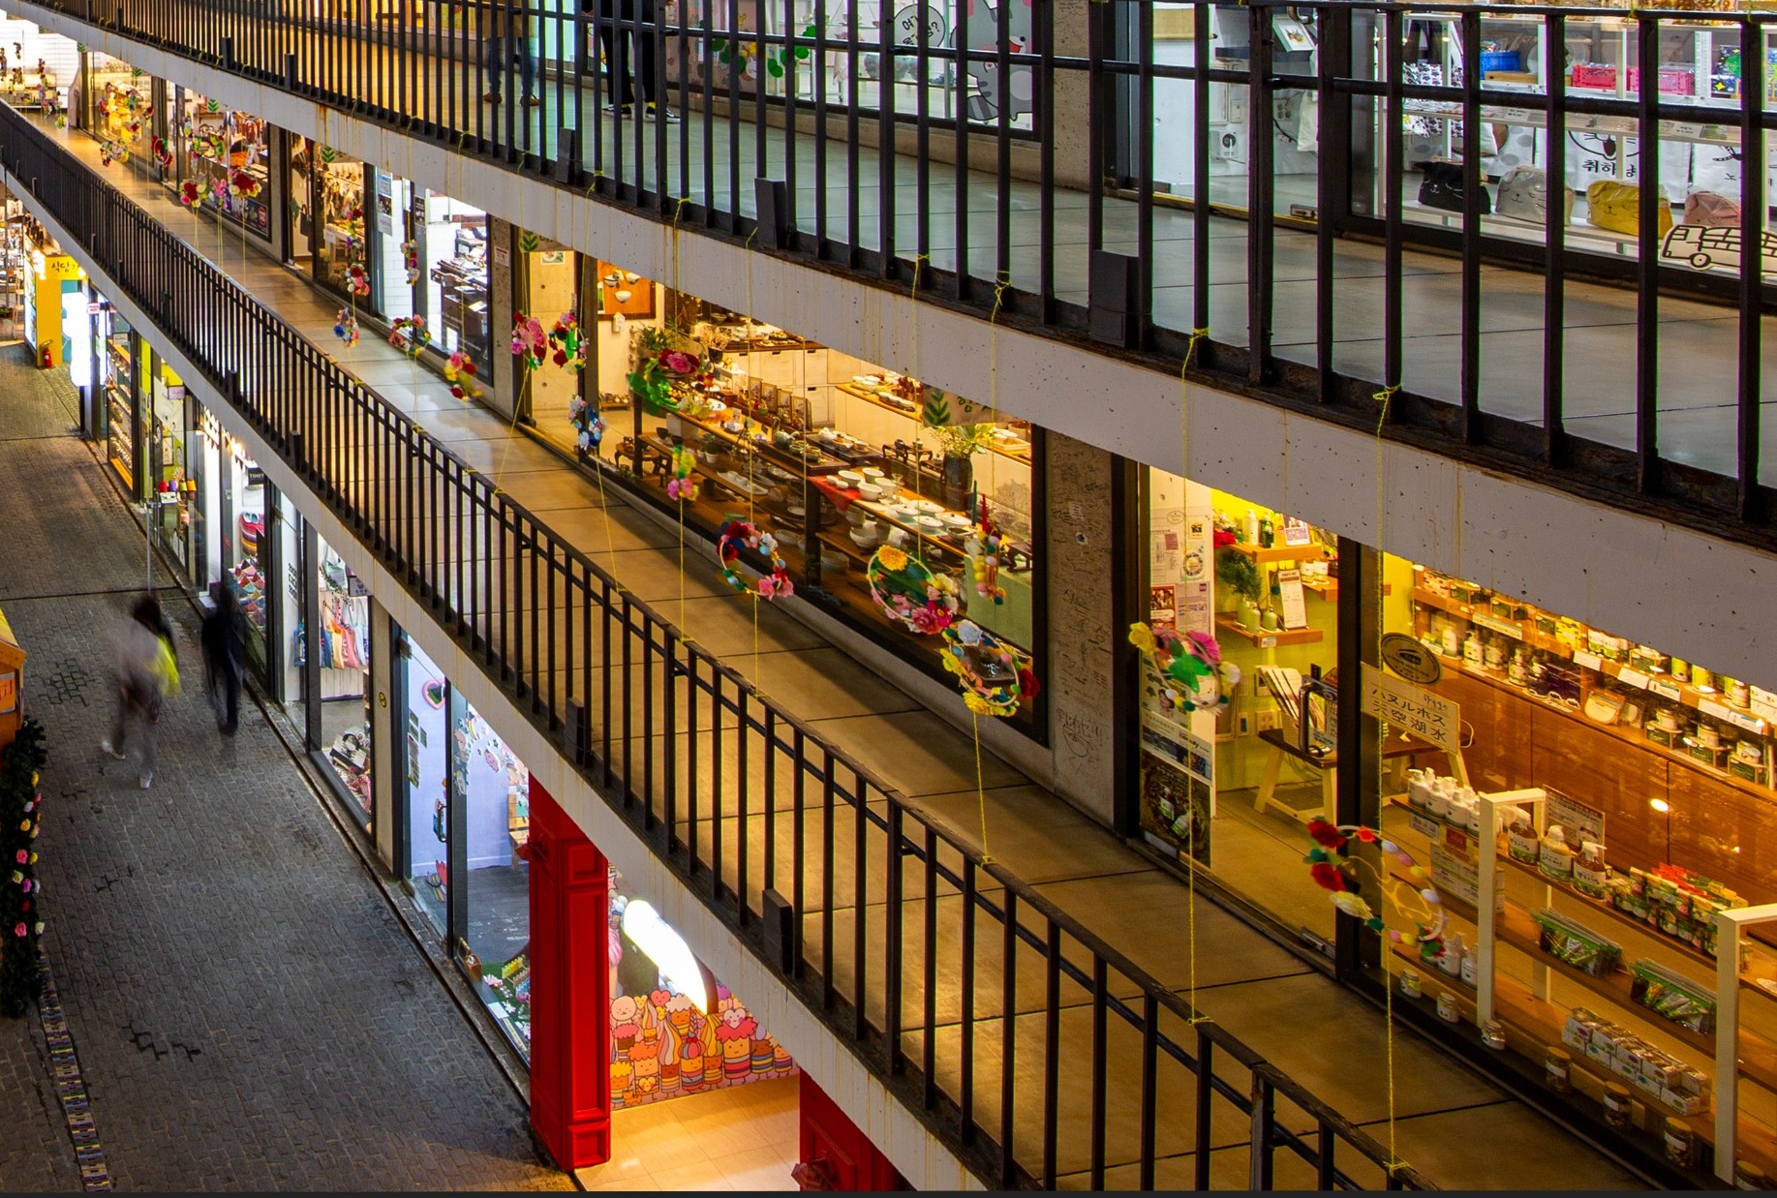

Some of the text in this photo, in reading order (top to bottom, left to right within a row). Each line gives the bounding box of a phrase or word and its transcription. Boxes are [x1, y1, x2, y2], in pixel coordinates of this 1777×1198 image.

[1371, 688, 1446, 727] ハヌルホス
